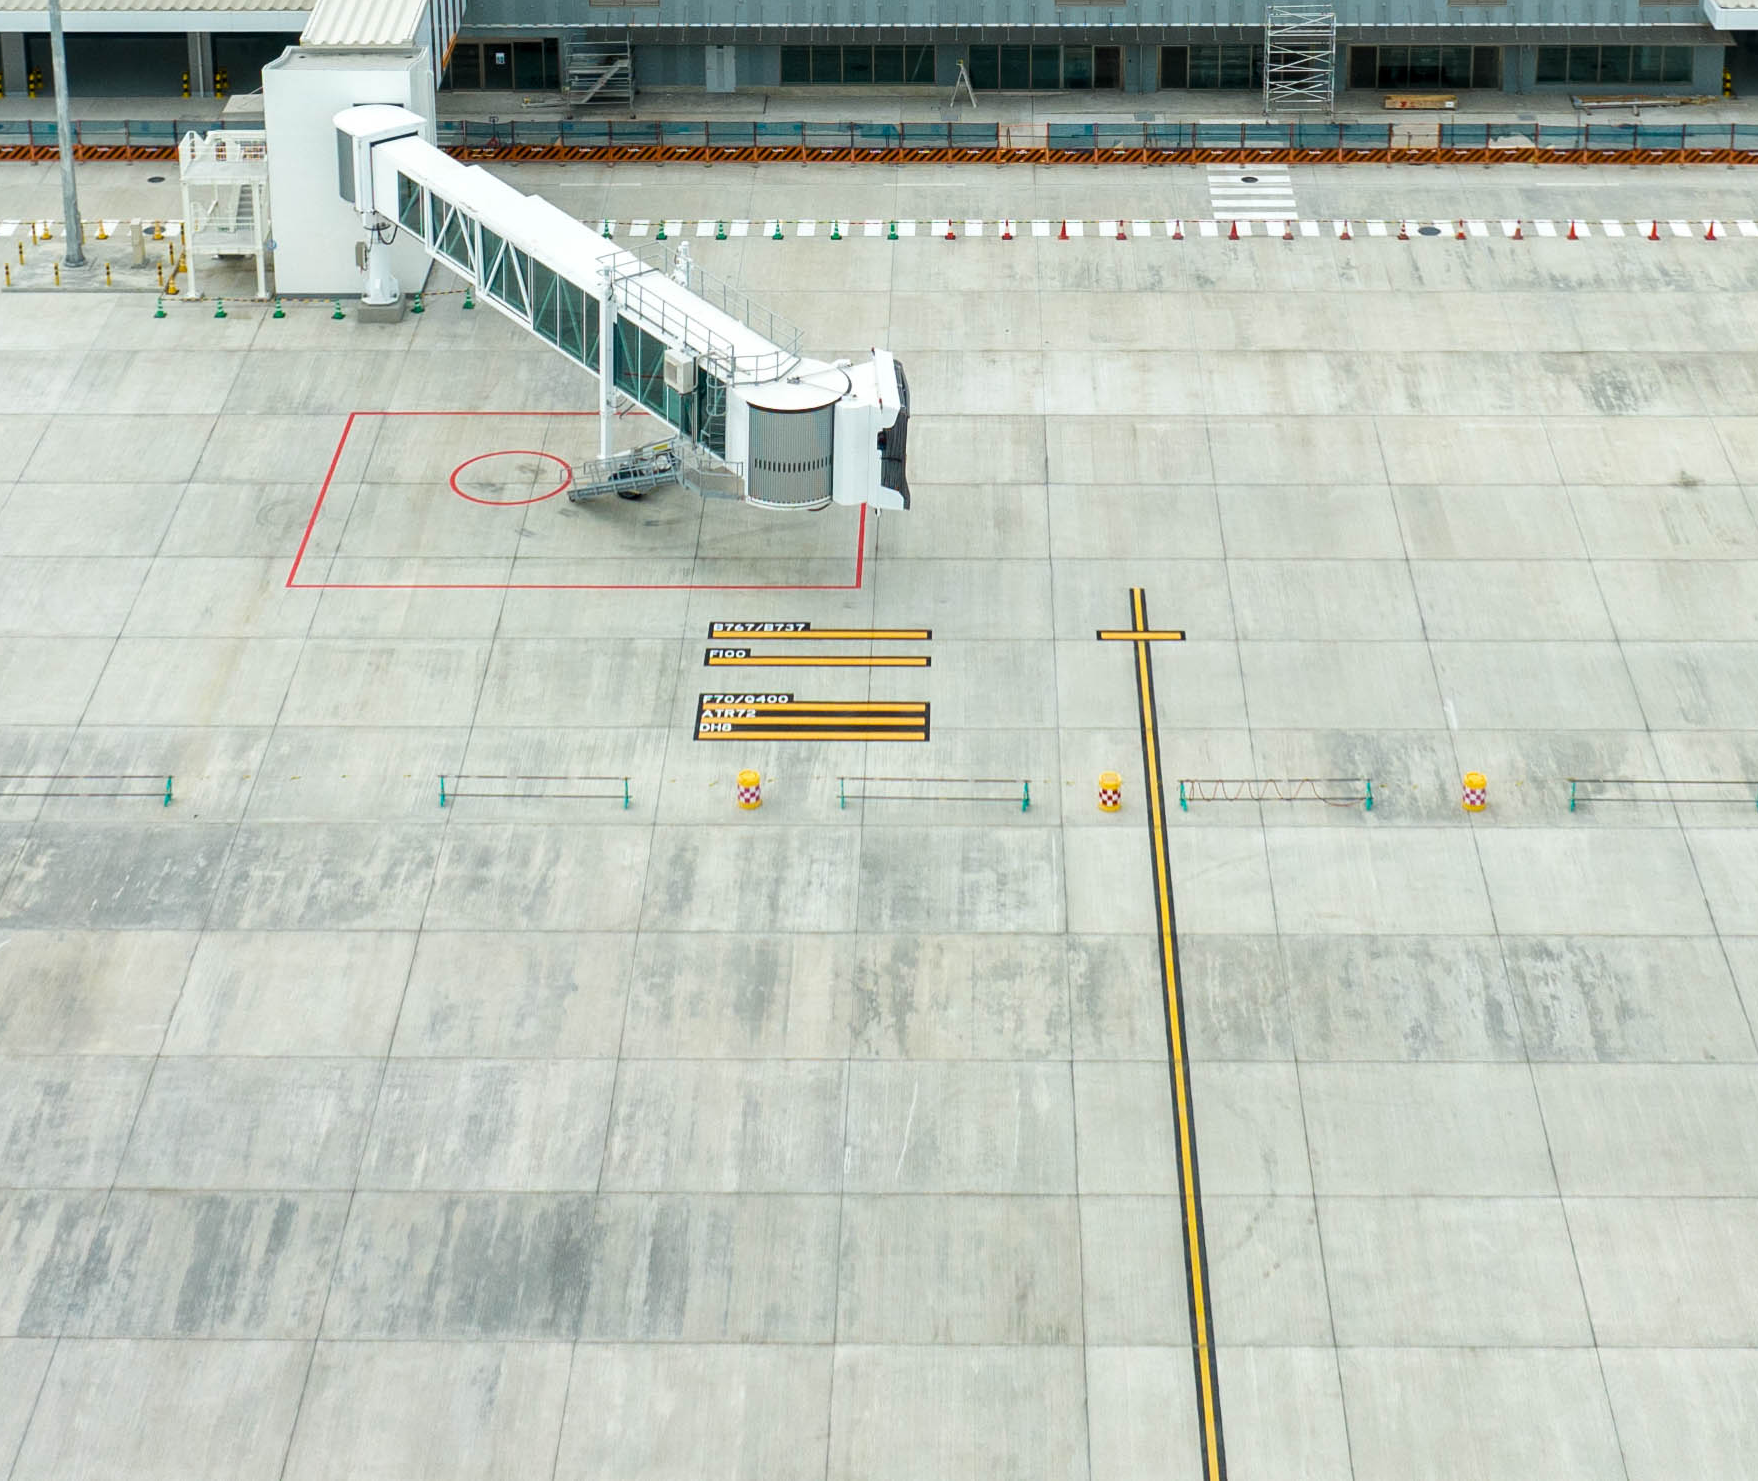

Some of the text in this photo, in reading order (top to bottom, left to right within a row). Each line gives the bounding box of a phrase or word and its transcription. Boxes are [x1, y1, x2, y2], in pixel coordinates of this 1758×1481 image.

[713, 623, 806, 632] B767/B737
[709, 650, 746, 658] F100
[701, 709, 756, 718] ATR72
[699, 723, 732, 732] DH8
